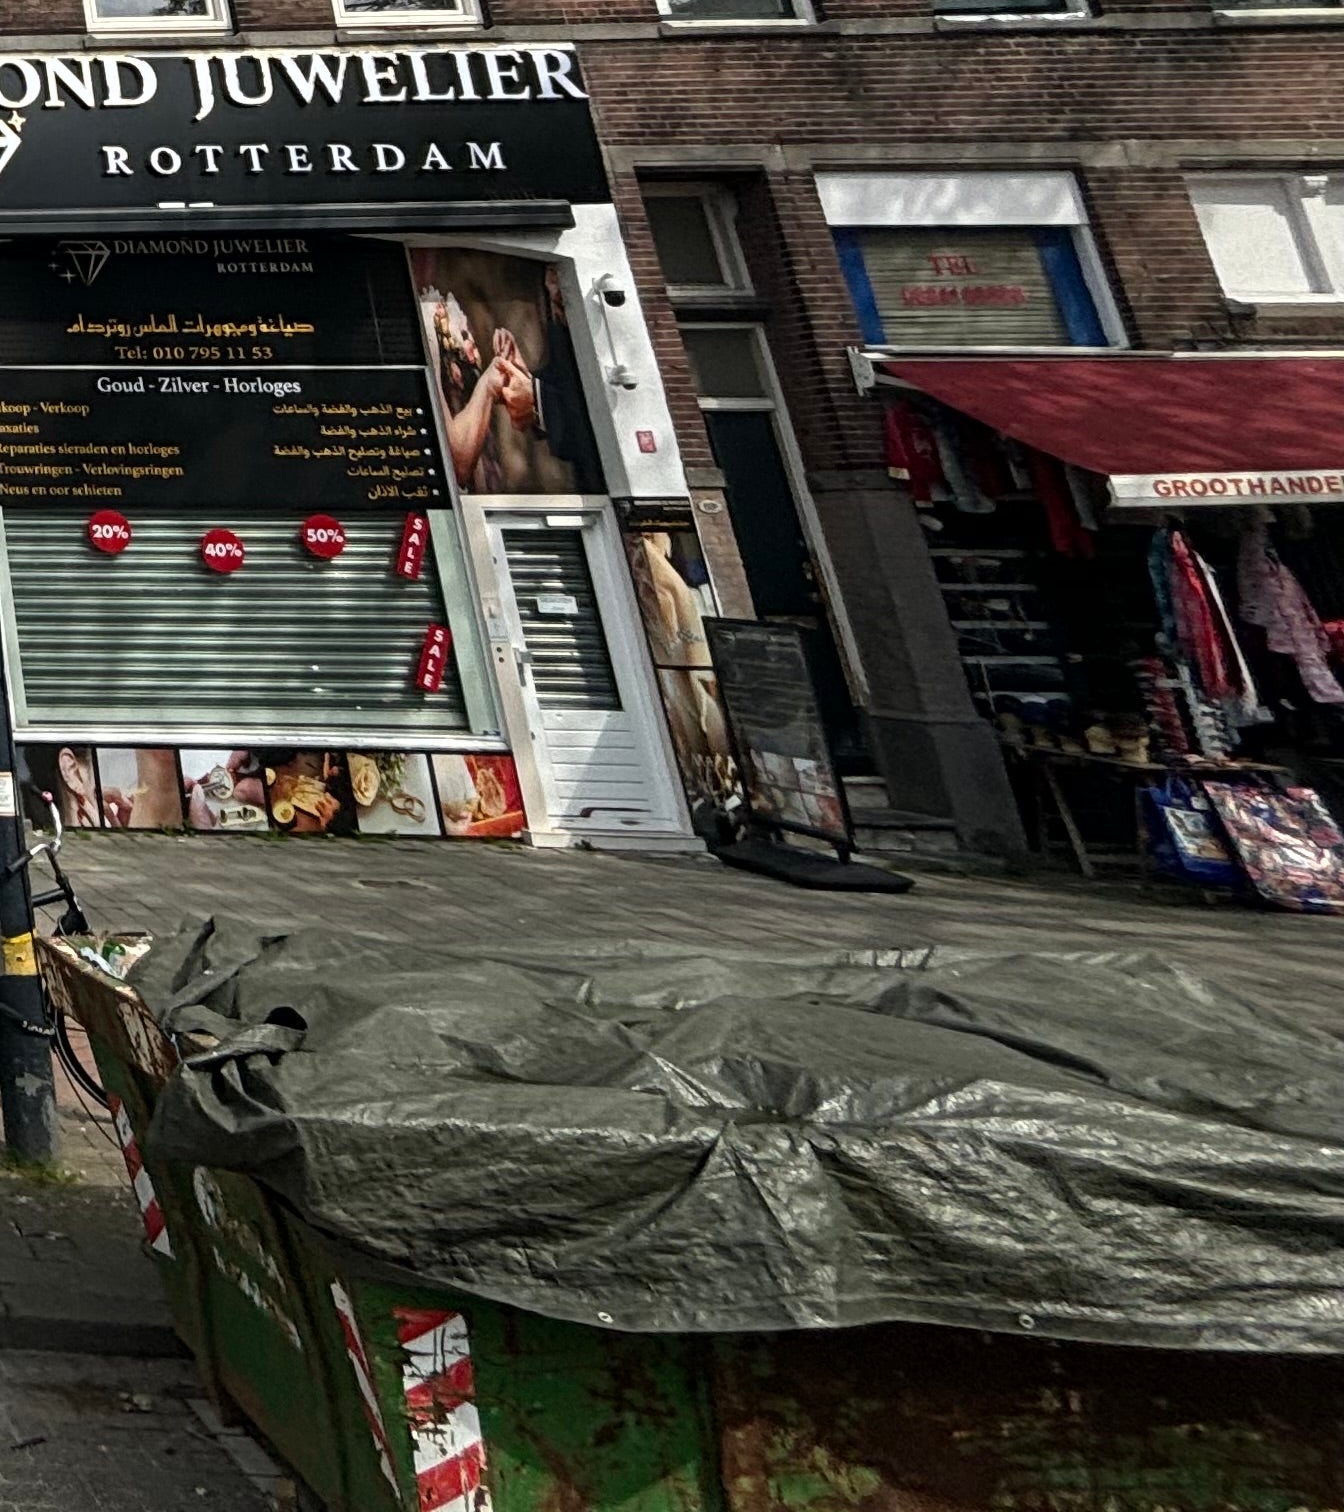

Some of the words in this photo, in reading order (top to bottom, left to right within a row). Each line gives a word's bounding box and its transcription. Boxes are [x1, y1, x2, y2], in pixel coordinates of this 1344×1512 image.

[188, 50, 590, 122] JUWELIER
[102, 142, 507, 175] ROTTERDAM
[114, 239, 209, 255] DIAMOND
[213, 238, 310, 257] JUWELIER
[216, 261, 313, 273] ROTTERDAM
[115, 346, 148, 360] Tel:
[153, 346, 185, 360] 010
[191, 346, 220, 360] 795
[227, 346, 246, 360] 11
[252, 346, 274, 359] 53
[97, 376, 145, 393] Goud
[158, 376, 210, 393] Zilver
[224, 376, 302, 397] Horloges
[40, 402, 90, 417] Verkoop
[58, 443, 111, 456] sieraden
[112, 446, 126, 455] en
[128, 443, 180, 458] horloges
[83, 463, 184, 479] Verlovingsringen
[0, 483, 30, 496] Neus
[32, 487, 47, 496] en
[49, 487, 69, 496] oor
[72, 483, 123, 497] schieten
[1152, 475, 1344, 499] GROOTHANDE
[91, 524, 129, 540] 20%
[306, 528, 344, 544] 50%
[204, 542, 243, 558] 40%
[403, 517, 424, 575] SALE
[423, 629, 445, 688] SALE
